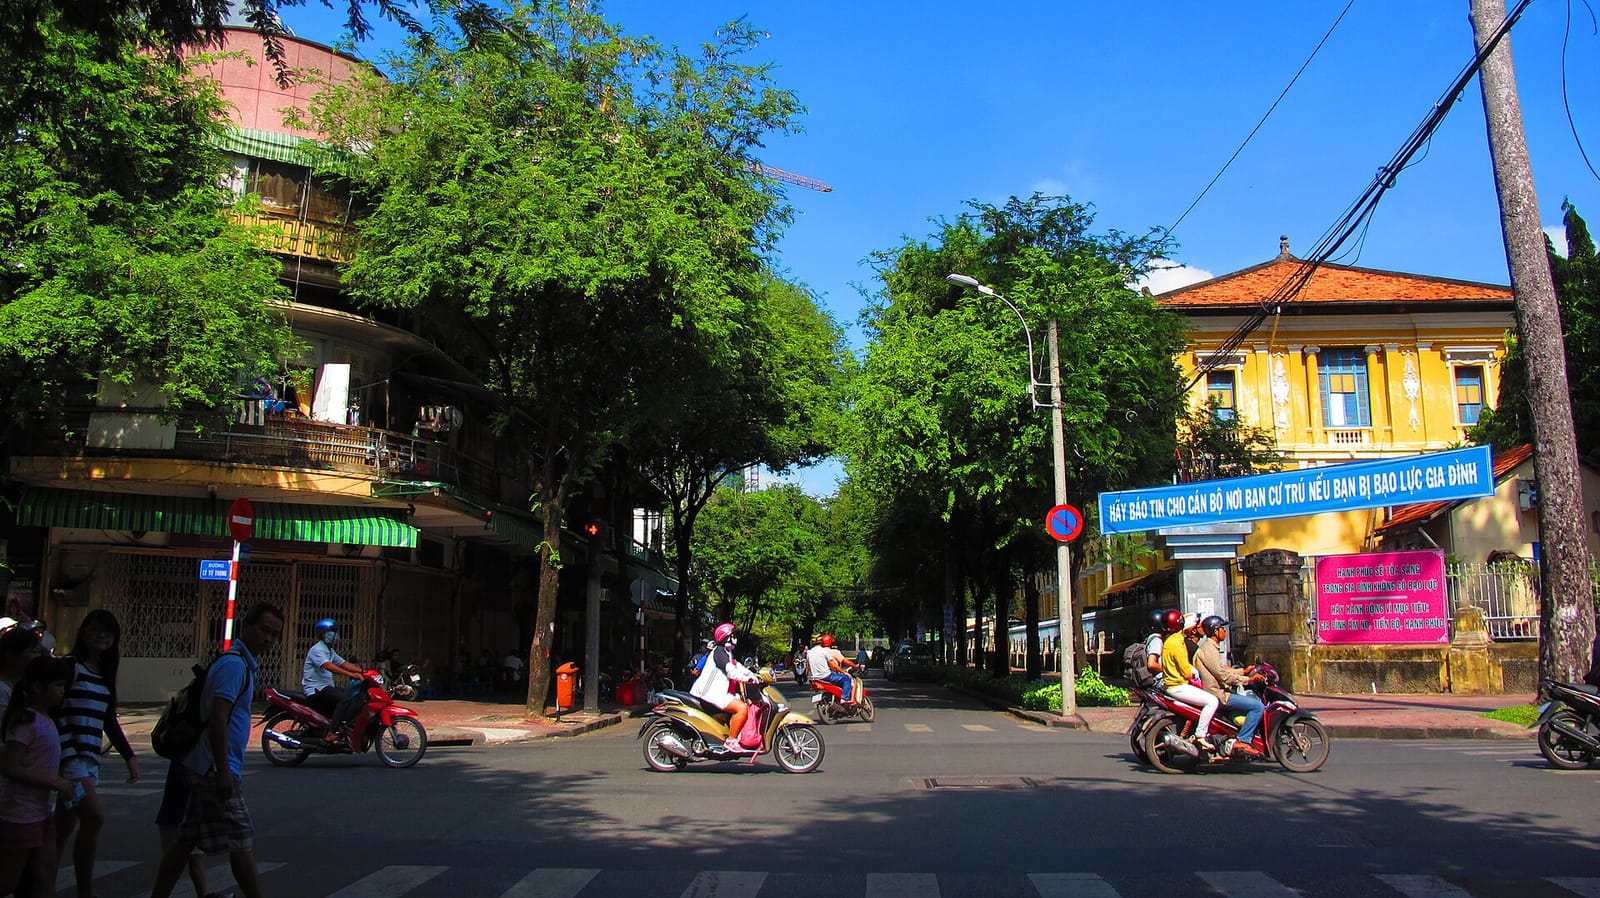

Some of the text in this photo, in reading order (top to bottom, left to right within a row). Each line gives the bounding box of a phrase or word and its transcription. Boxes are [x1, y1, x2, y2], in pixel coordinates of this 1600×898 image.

[1129, 495, 1148, 520] BÁO
[1149, 498, 1165, 519] TIN
[1166, 497, 1186, 515] CHO
[1187, 489, 1207, 515] CÁN
[1209, 487, 1223, 516] BỘ
[1226, 488, 1242, 511] NƠI
[1245, 487, 1267, 512] BẠN
[1268, 481, 1283, 506] CƯ
[1285, 477, 1305, 504] TRÚ
[1309, 472, 1331, 501] NẾU
[1333, 476, 1357, 502] BẠN
[1359, 474, 1372, 500] BỊ
[1374, 470, 1397, 498] BẠO
[1400, 465, 1423, 494] LỰC
[1425, 466, 1446, 487] GIA
[1448, 458, 1477, 486] ĐÌNH
